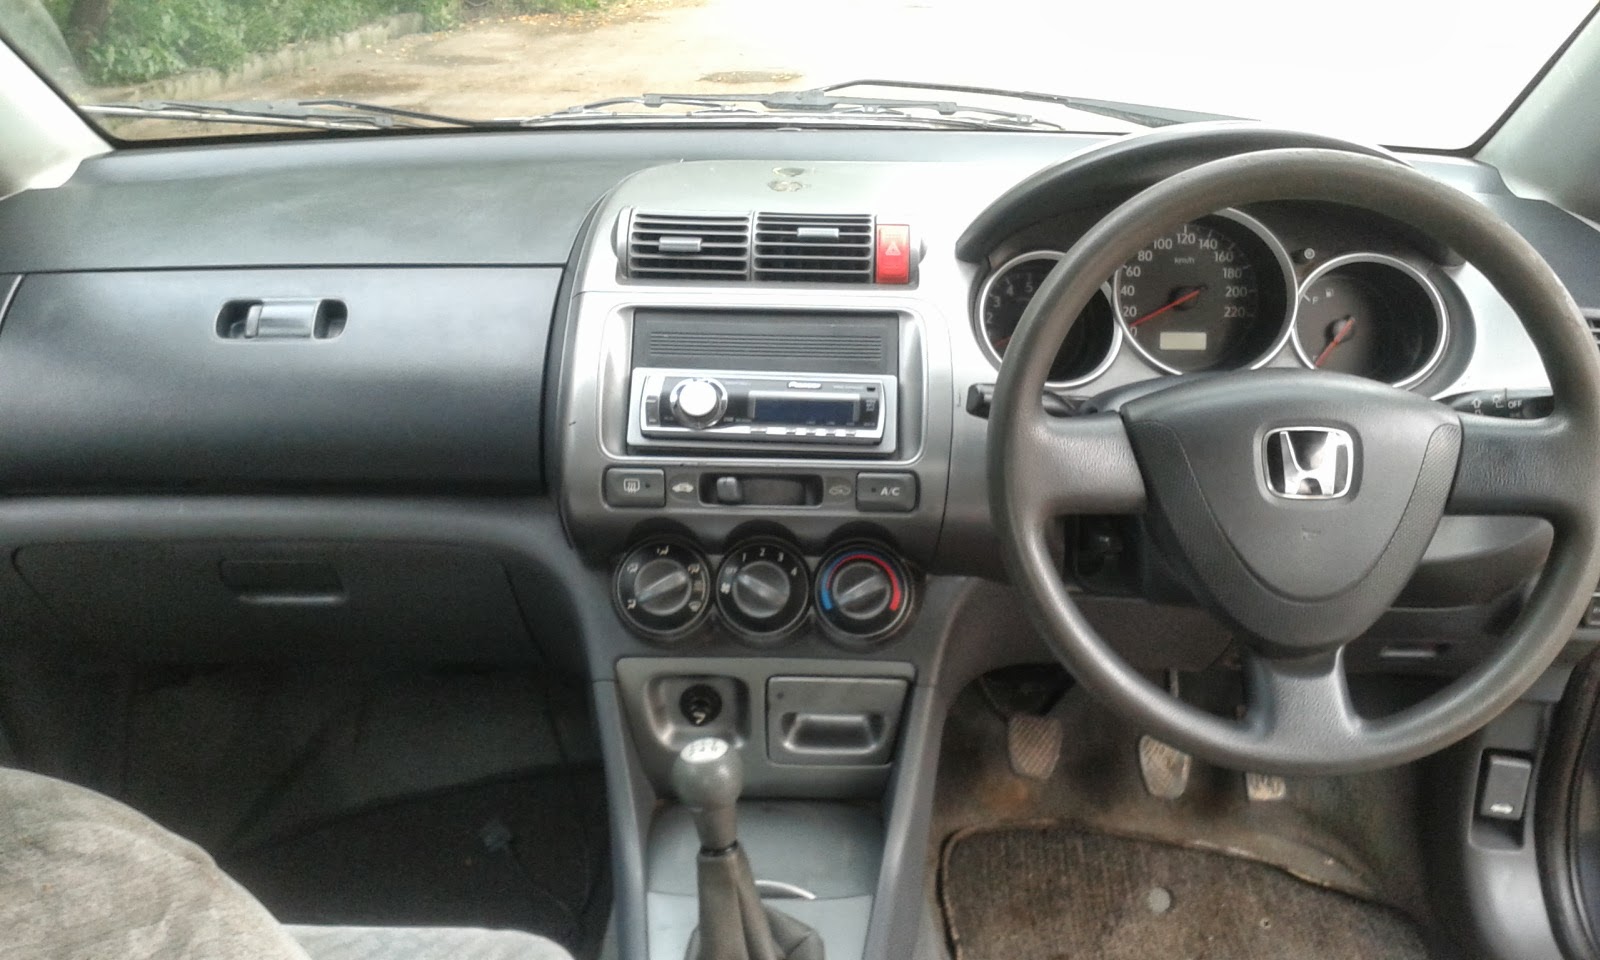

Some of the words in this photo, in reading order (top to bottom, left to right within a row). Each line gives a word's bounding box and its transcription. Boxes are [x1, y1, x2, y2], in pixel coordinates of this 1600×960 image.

[1153, 238, 1173, 250] 100
[1176, 233, 1196, 244] 120
[1198, 238, 1218, 250] 140
[1137, 250, 1153, 261] 80
[1213, 251, 1234, 262] 160
[1125, 266, 1141, 278] 60
[1222, 267, 1242, 279] 180
[1120, 285, 1135, 296] 40
[1225, 286, 1247, 297] 200
[1123, 306, 1137, 317] 20
[1223, 306, 1246, 318] 220
[1507, 399, 1523, 409] OFF
[879, 486, 901, 496] A/C
